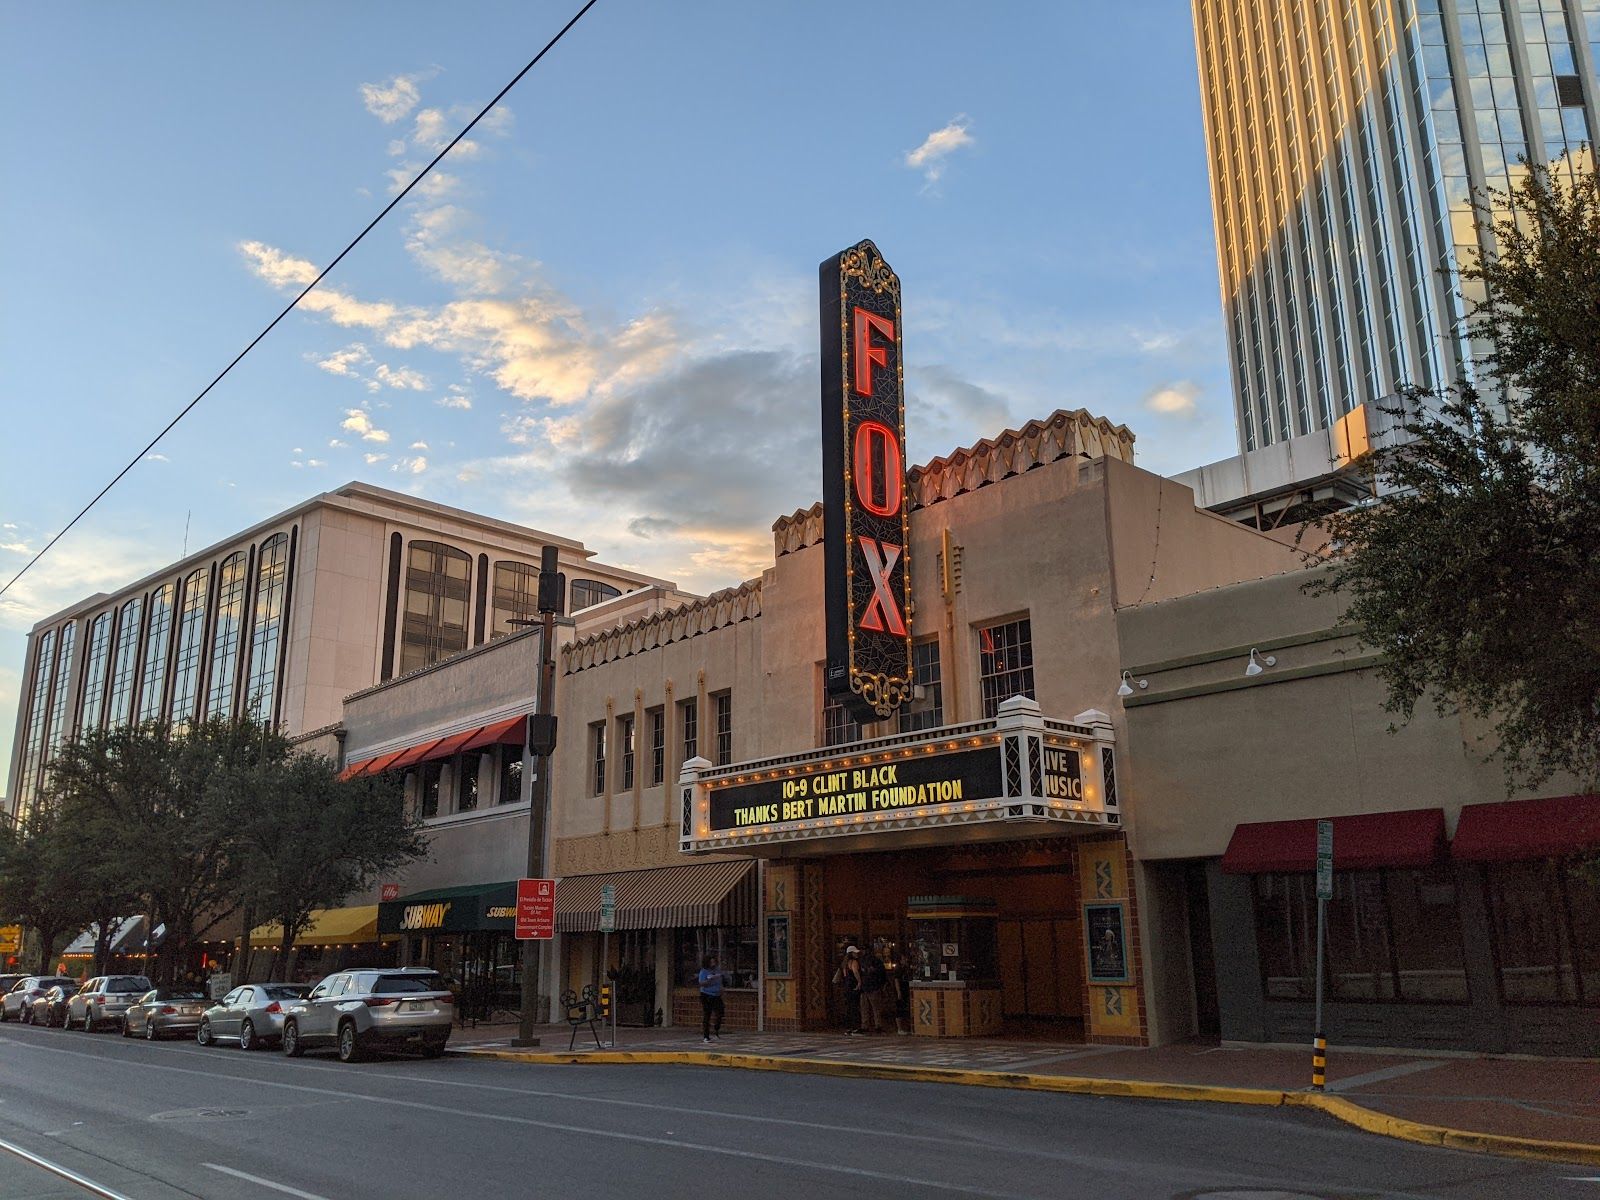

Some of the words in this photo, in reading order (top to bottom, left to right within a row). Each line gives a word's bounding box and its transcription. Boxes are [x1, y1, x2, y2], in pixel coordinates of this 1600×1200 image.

[853, 304, 906, 635] FOX
[1044, 750, 1068, 772] IVE
[782, 778, 808, 799] 10-9
[812, 772, 848, 795] CLINT
[852, 764, 898, 789] BLACK
[734, 803, 778, 826] THANKS
[782, 798, 814, 820] BERT
[818, 791, 867, 816] MARTIN
[871, 779, 963, 809] FOUNDATION
[383, 886, 398, 899] illy
[400, 902, 451, 930] SUBWAY
[486, 906, 517, 918] SUBW
